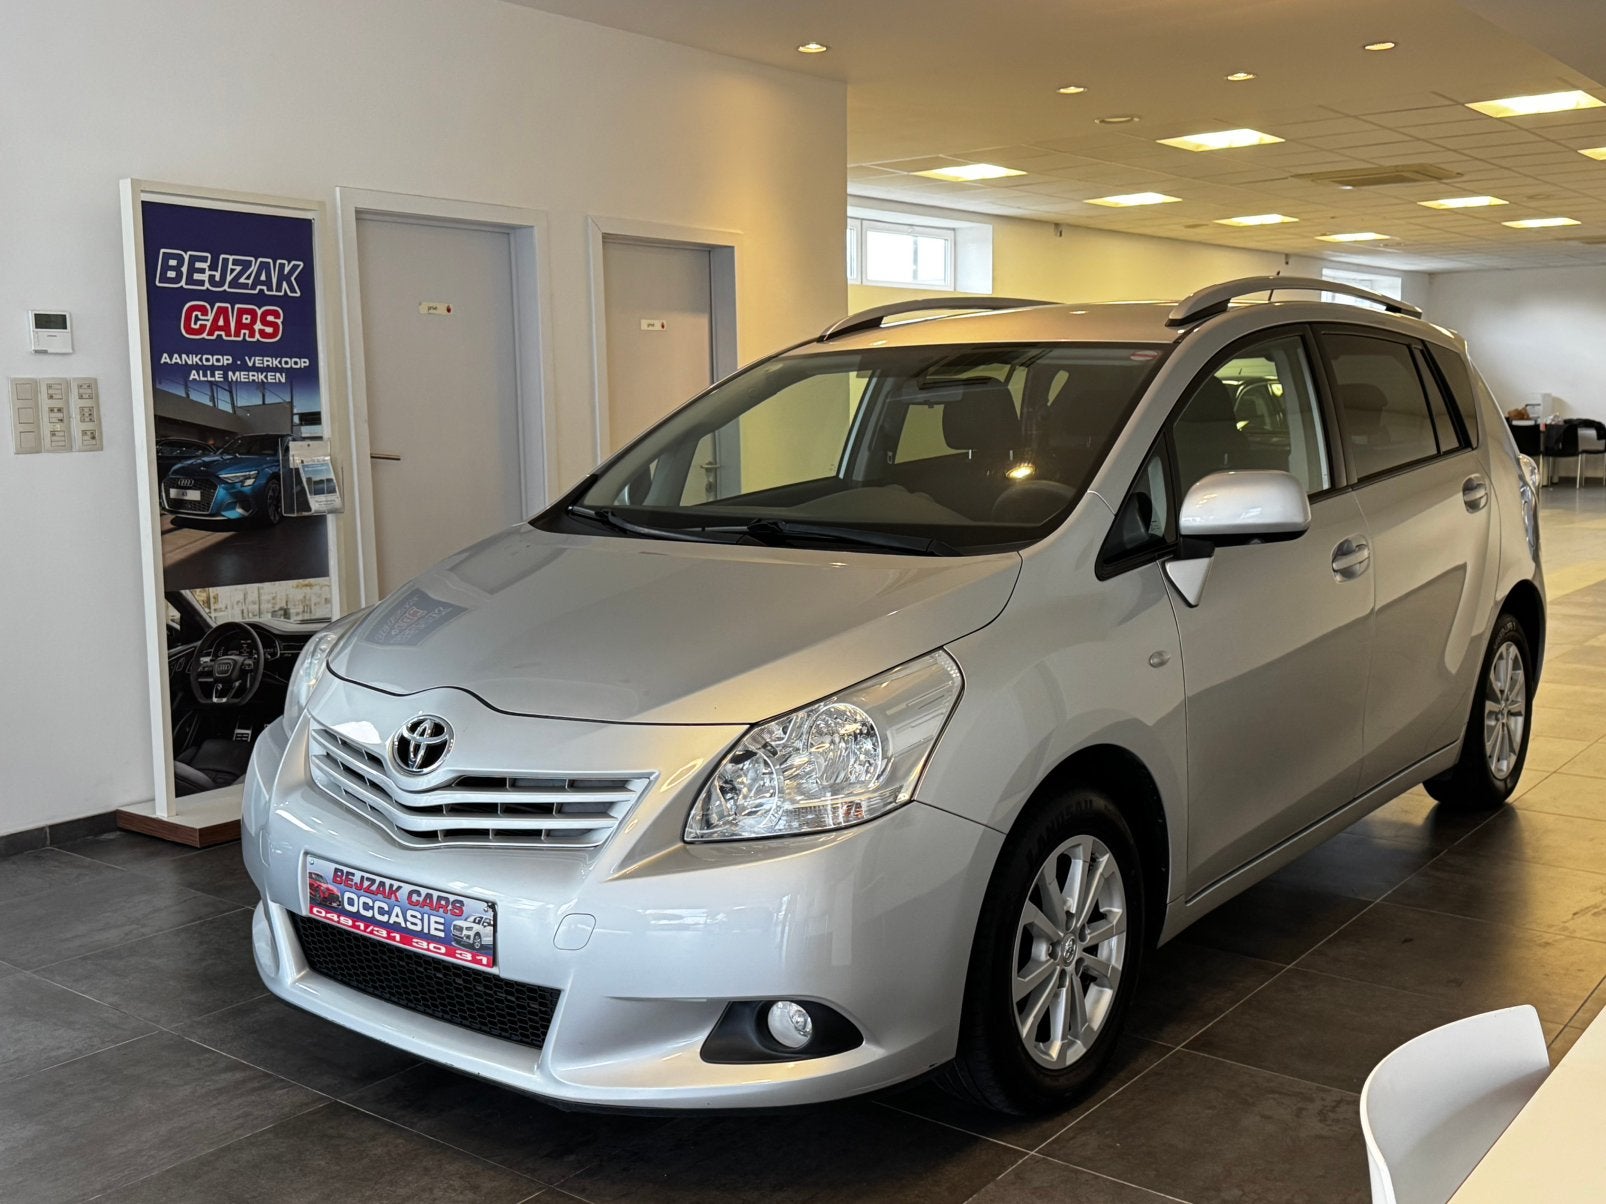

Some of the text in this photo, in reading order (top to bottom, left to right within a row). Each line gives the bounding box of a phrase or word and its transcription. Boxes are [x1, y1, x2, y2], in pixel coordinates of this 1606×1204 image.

[156, 249, 304, 296] BEJZAK
[181, 301, 283, 342] CARS
[160, 353, 232, 366] AANKOOP
[245, 356, 309, 368] VERKOOP
[189, 369, 286, 383] ALLE MERKEN
[332, 867, 465, 917] BEJZAK CARS
[343, 891, 446, 938] OCCASIE
[312, 907, 488, 965] 0491/31 30 31
